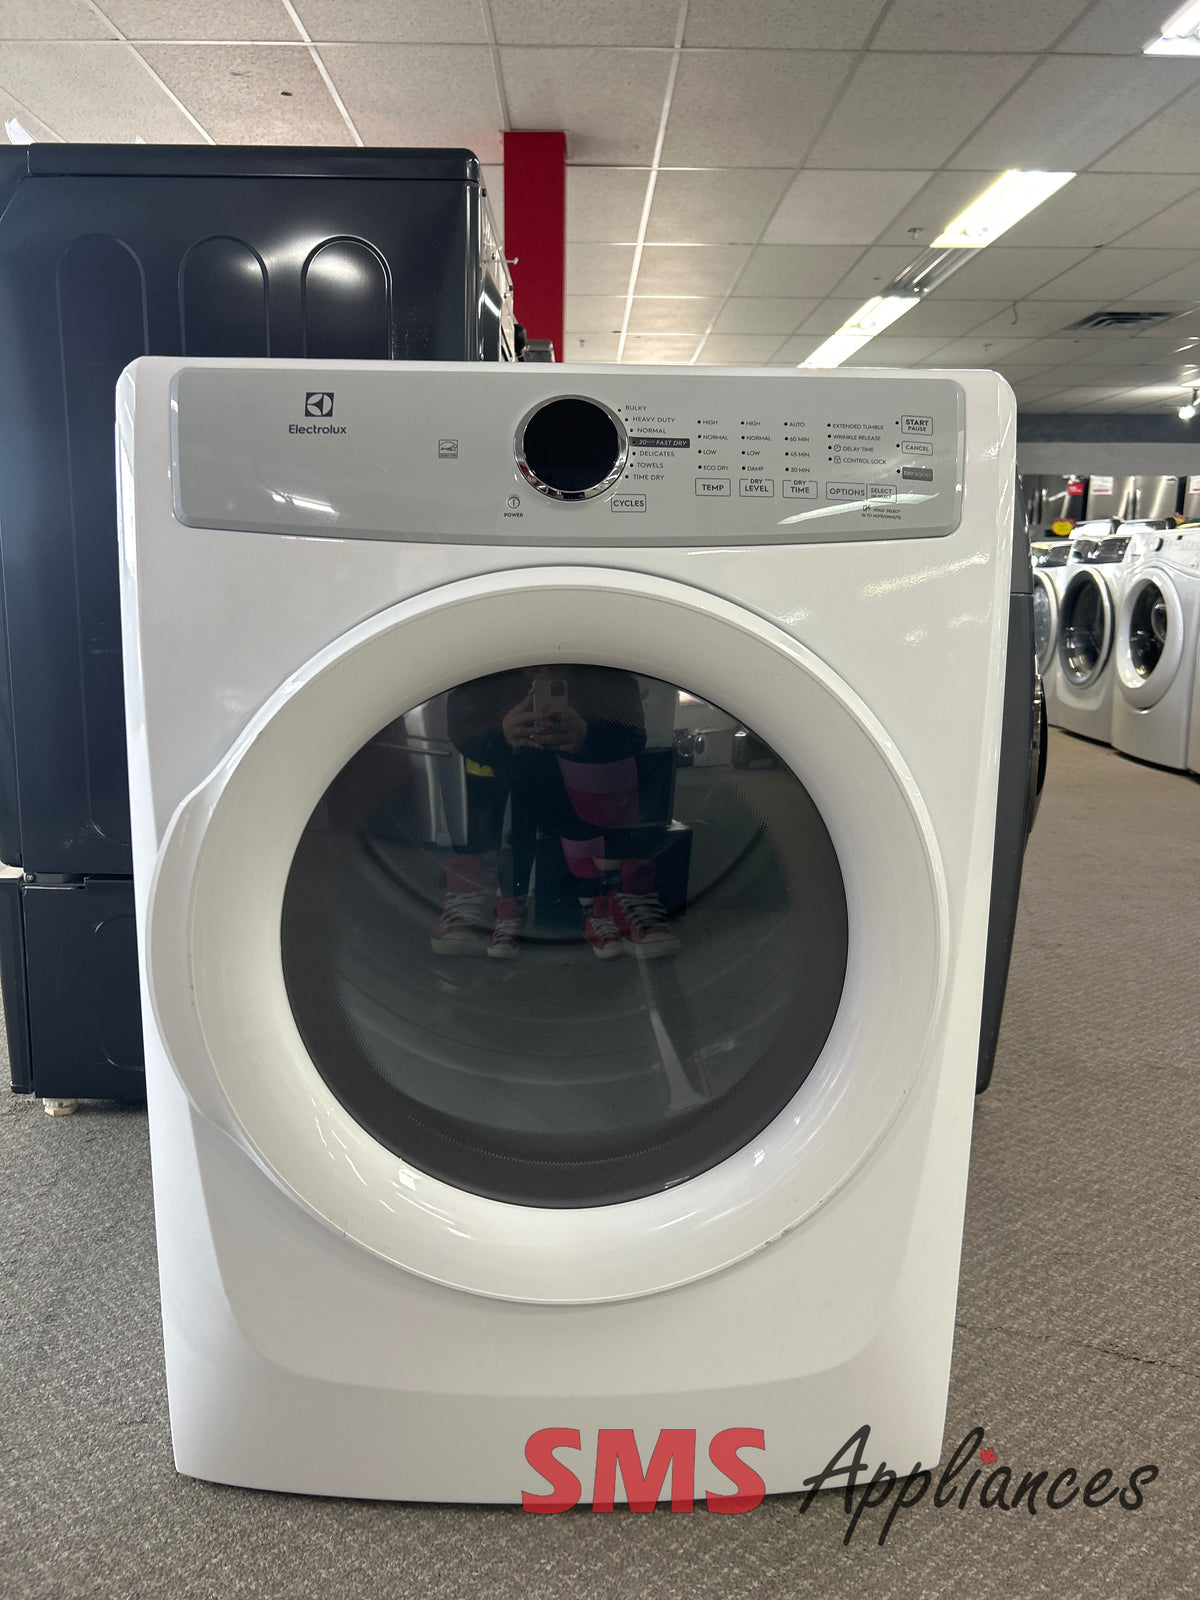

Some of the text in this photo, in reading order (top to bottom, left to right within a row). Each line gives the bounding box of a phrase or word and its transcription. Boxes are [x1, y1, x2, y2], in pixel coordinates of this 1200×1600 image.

[288, 424, 347, 434] Electrolux
[702, 484, 724, 492] TEMP
[744, 485, 769, 493] LEVEL
[790, 486, 810, 494] TIME
[829, 488, 865, 496] OPTIONS
